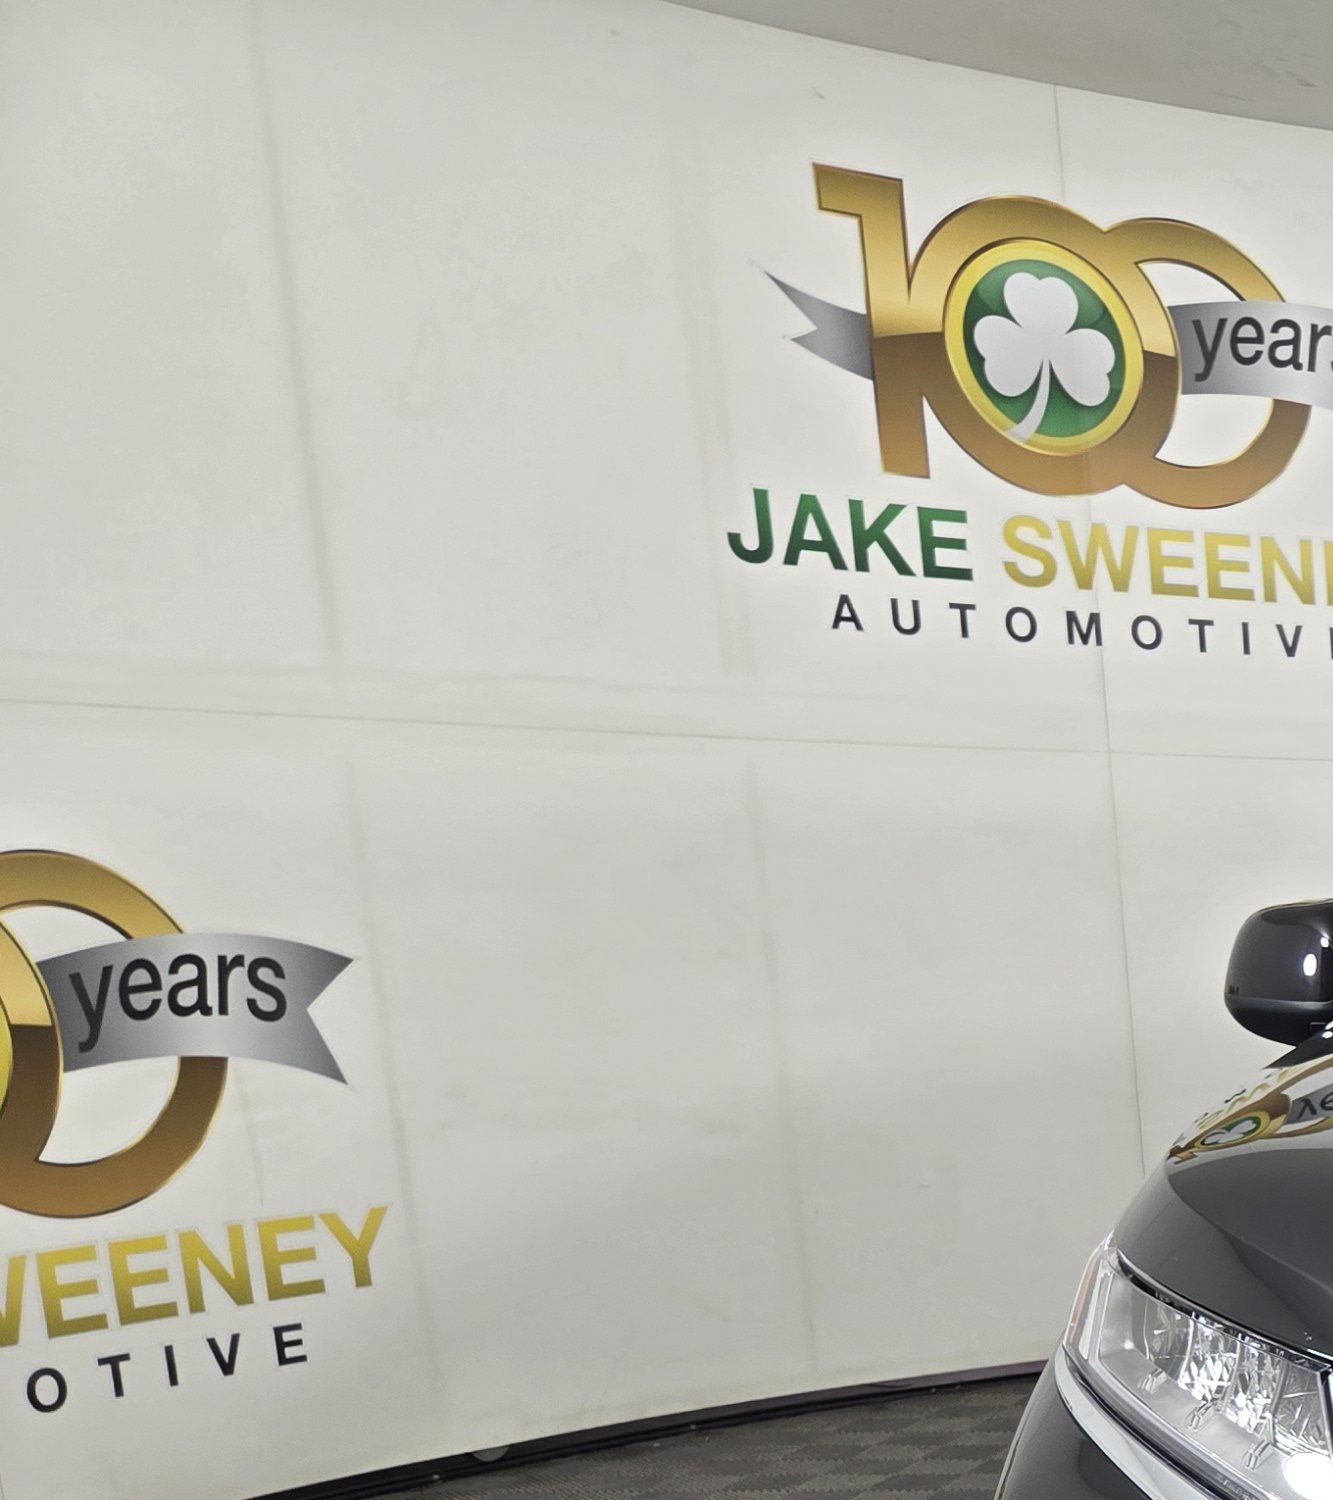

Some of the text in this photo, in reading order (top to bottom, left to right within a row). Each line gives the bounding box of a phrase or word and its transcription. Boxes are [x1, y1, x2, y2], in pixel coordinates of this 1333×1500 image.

[727, 487, 974, 582] JAKE
[69, 952, 287, 1052] years
[0, 1206, 389, 1348] EENEY
[26, 1323, 308, 1413] OTIVE
